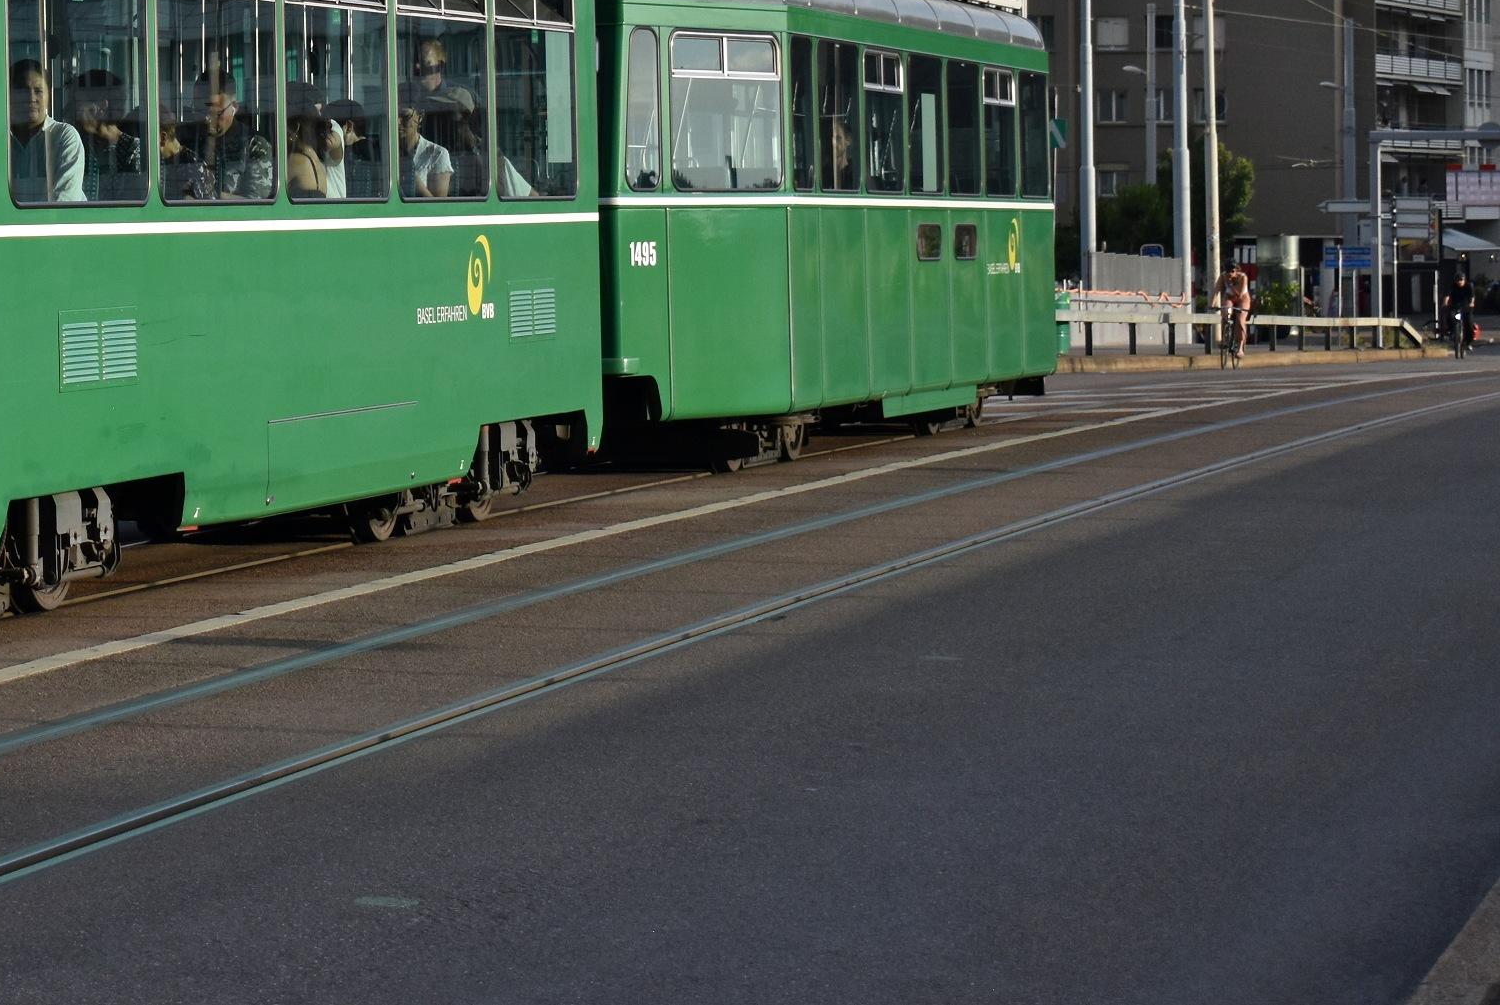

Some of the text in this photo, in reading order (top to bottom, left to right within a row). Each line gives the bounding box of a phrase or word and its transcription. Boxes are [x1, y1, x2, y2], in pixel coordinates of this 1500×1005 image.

[629, 241, 657, 266] 1495
[416, 304, 468, 324] BASEL ERFAHREN
[481, 302, 494, 319] BVB
